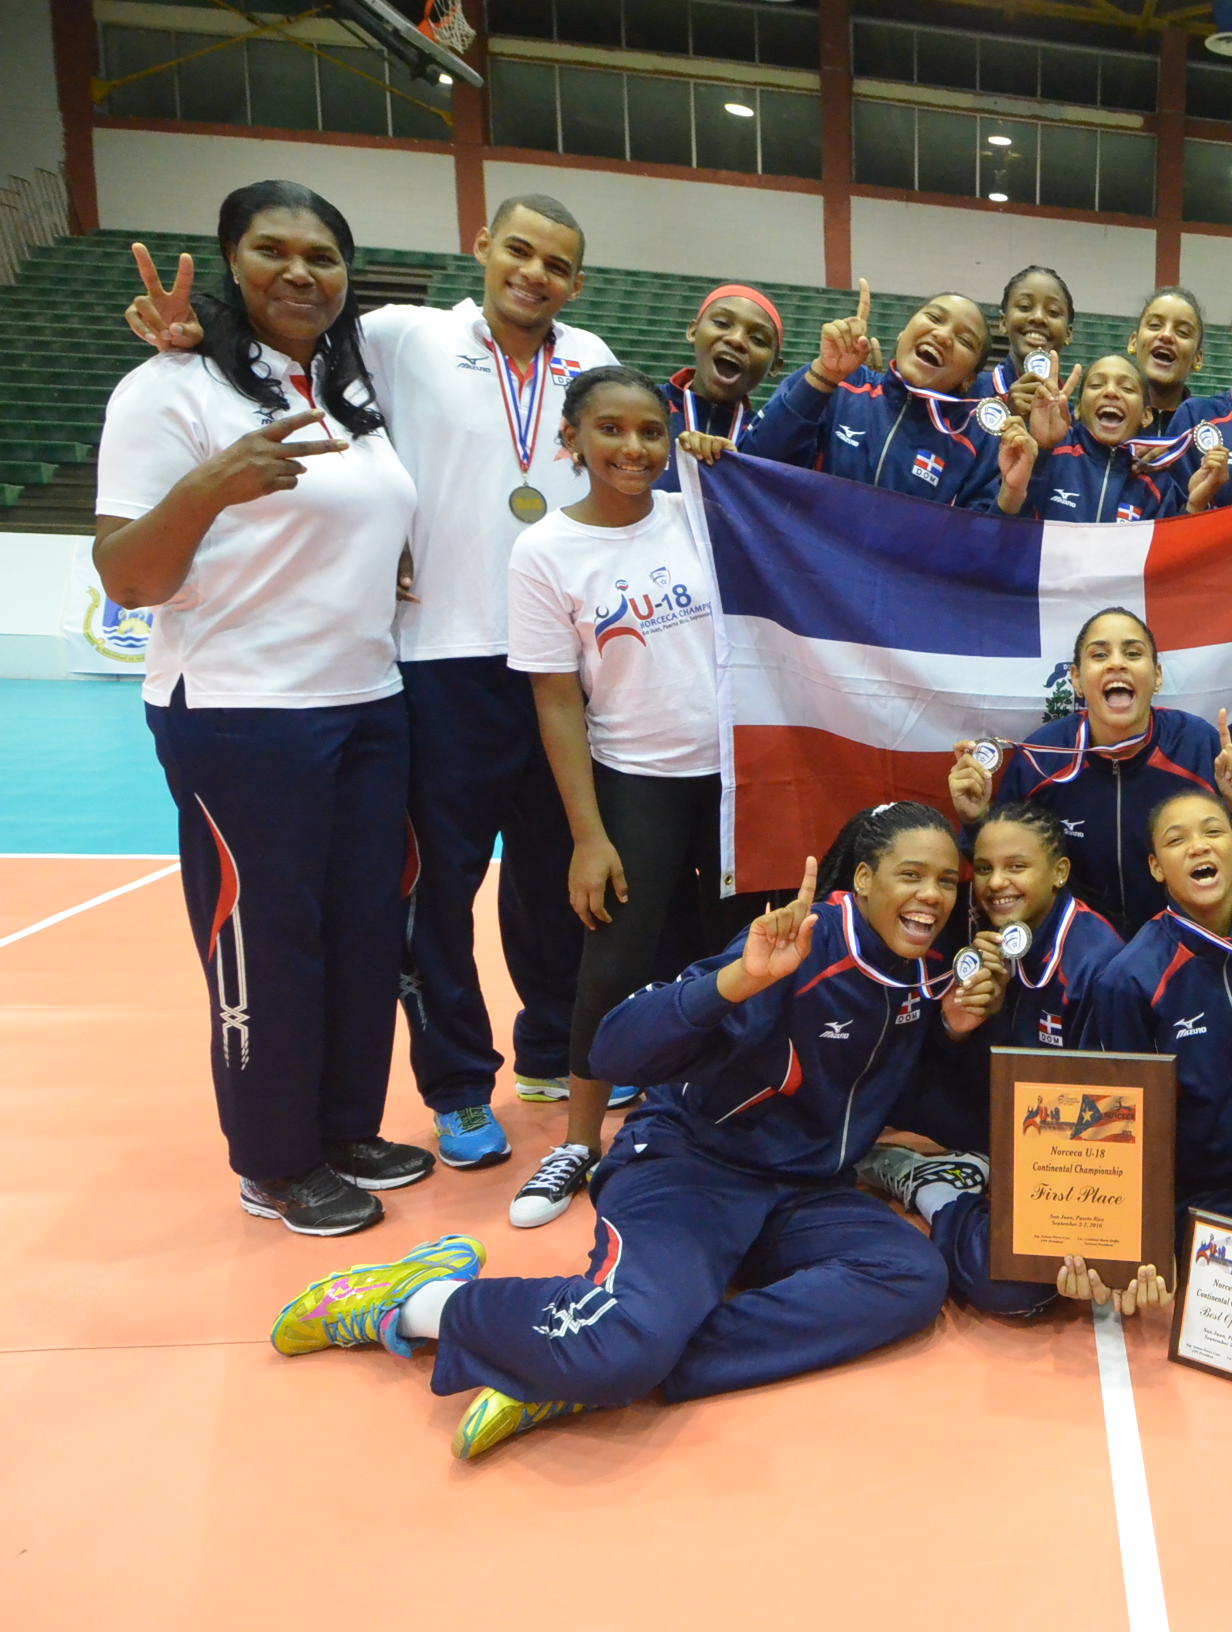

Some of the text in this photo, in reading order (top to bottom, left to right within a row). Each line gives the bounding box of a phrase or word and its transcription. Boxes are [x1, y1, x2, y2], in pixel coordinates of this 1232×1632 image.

[915, 468, 937, 483] DOM
[629, 583, 692, 620] U-18
[899, 1011, 918, 1022] DOM
[1041, 1033, 1060, 1044] DOM
[1051, 1146, 1106, 1159] Norceca U-18
[1033, 1161, 1124, 1177] Continental Championship
[1030, 1182, 1125, 1204] First Place
[1196, 1288, 1230, 1305] Continental
[1200, 1306, 1223, 1320] Best
